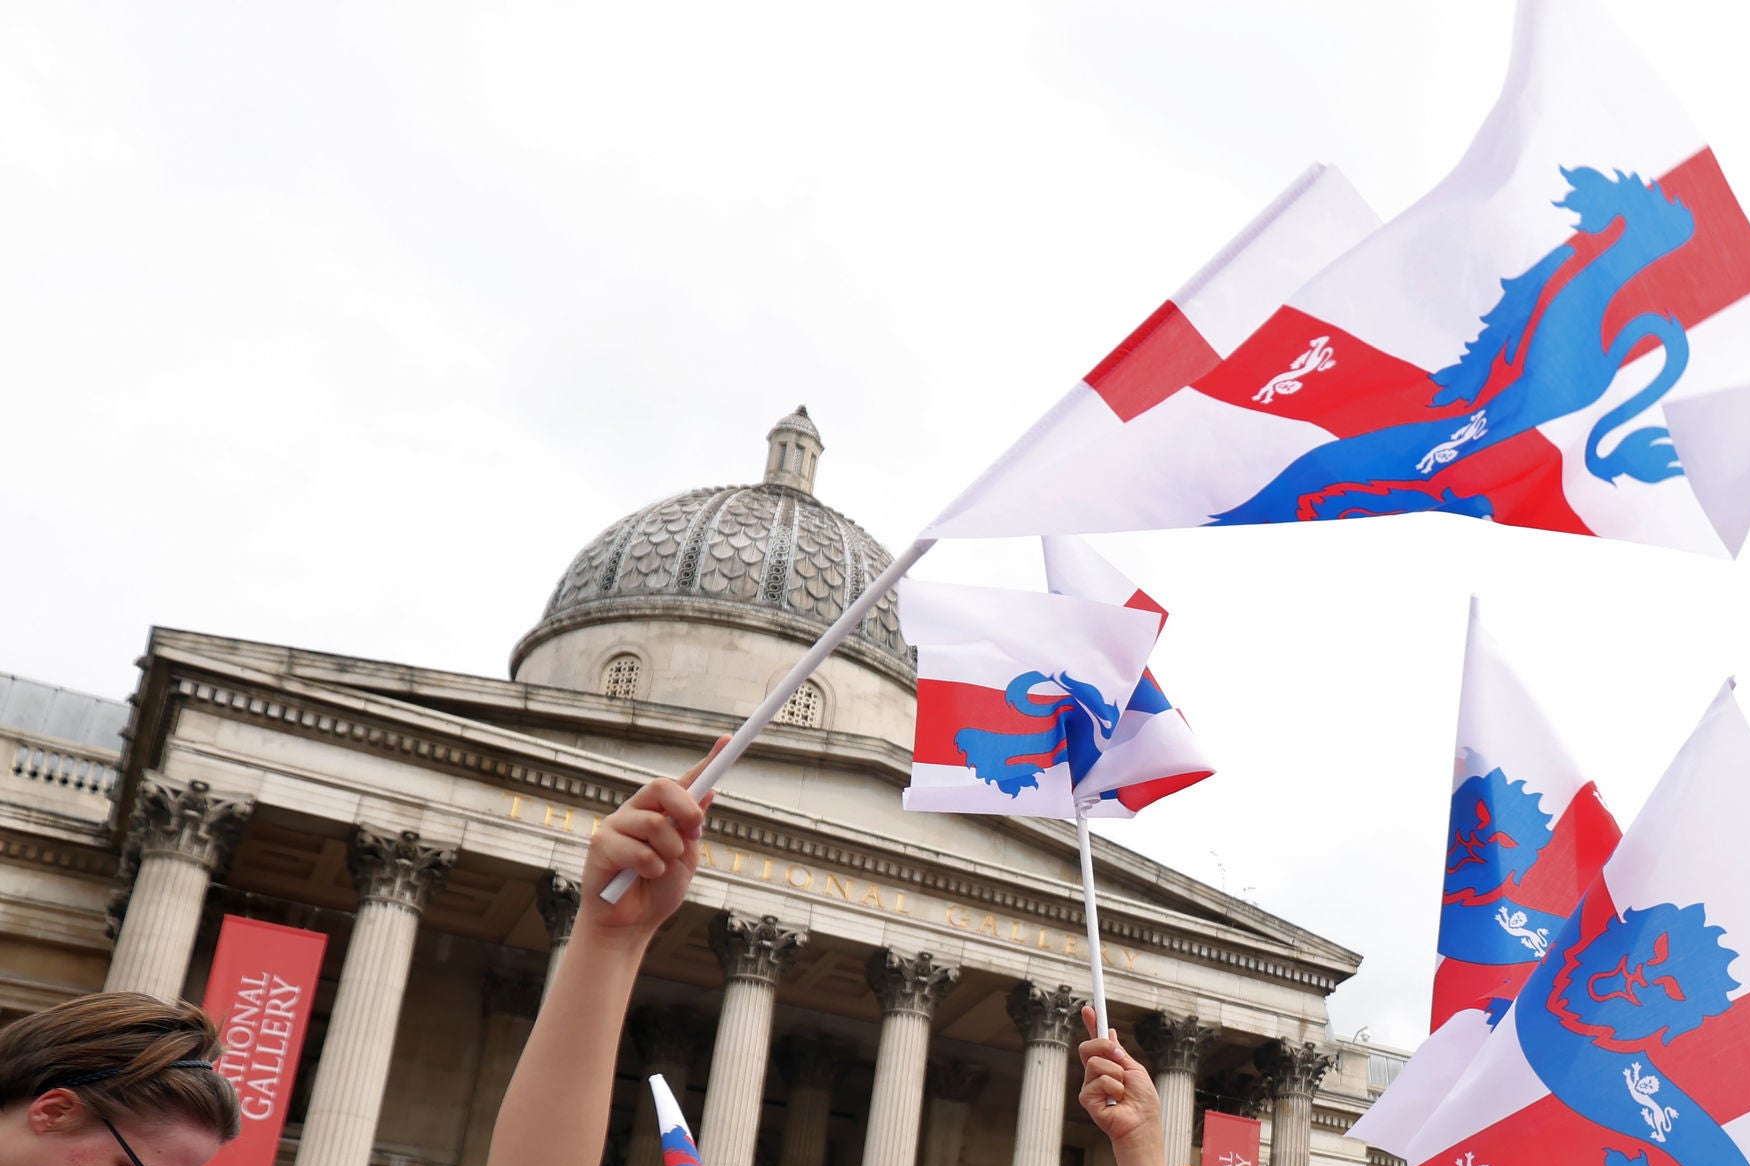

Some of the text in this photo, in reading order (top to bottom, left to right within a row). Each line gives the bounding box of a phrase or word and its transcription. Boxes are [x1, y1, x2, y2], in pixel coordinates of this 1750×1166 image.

[698, 842, 912, 915] ATIONAL
[218, 971, 271, 1093] ATIONAL
[240, 975, 302, 1121] GALLERY
